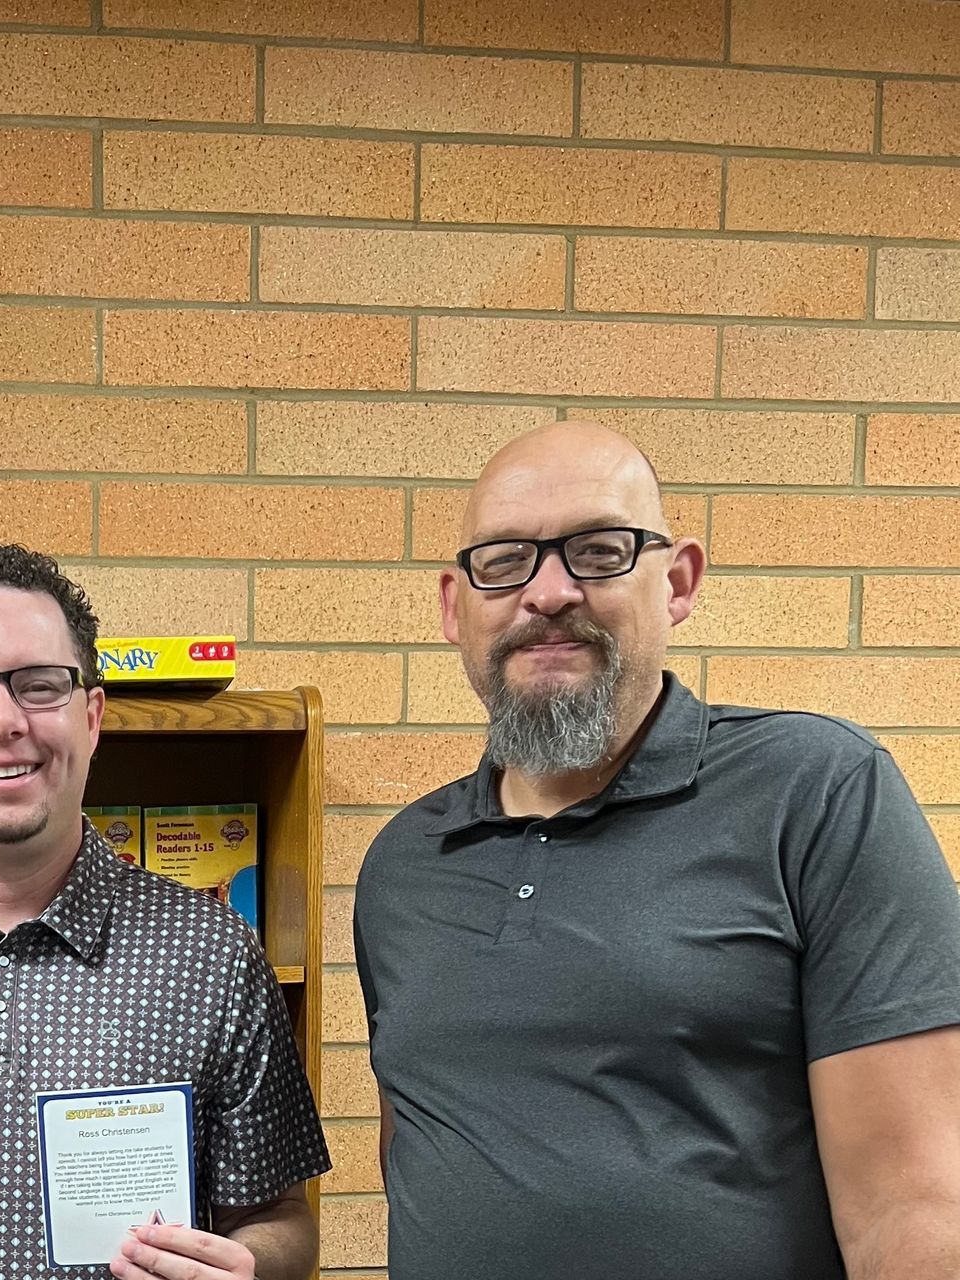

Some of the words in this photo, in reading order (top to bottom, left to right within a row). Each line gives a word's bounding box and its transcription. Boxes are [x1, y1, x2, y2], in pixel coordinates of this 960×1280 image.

[156, 832, 201, 842] Decodable
[156, 844, 192, 854] Readers
[194, 843, 214, 852] 1-15
[65, 1107, 115, 1120] SUPER
[117, 1103, 165, 1116] STAR!
[78, 1129, 99, 1138] Ross
[101, 1125, 150, 1137] Christensen
